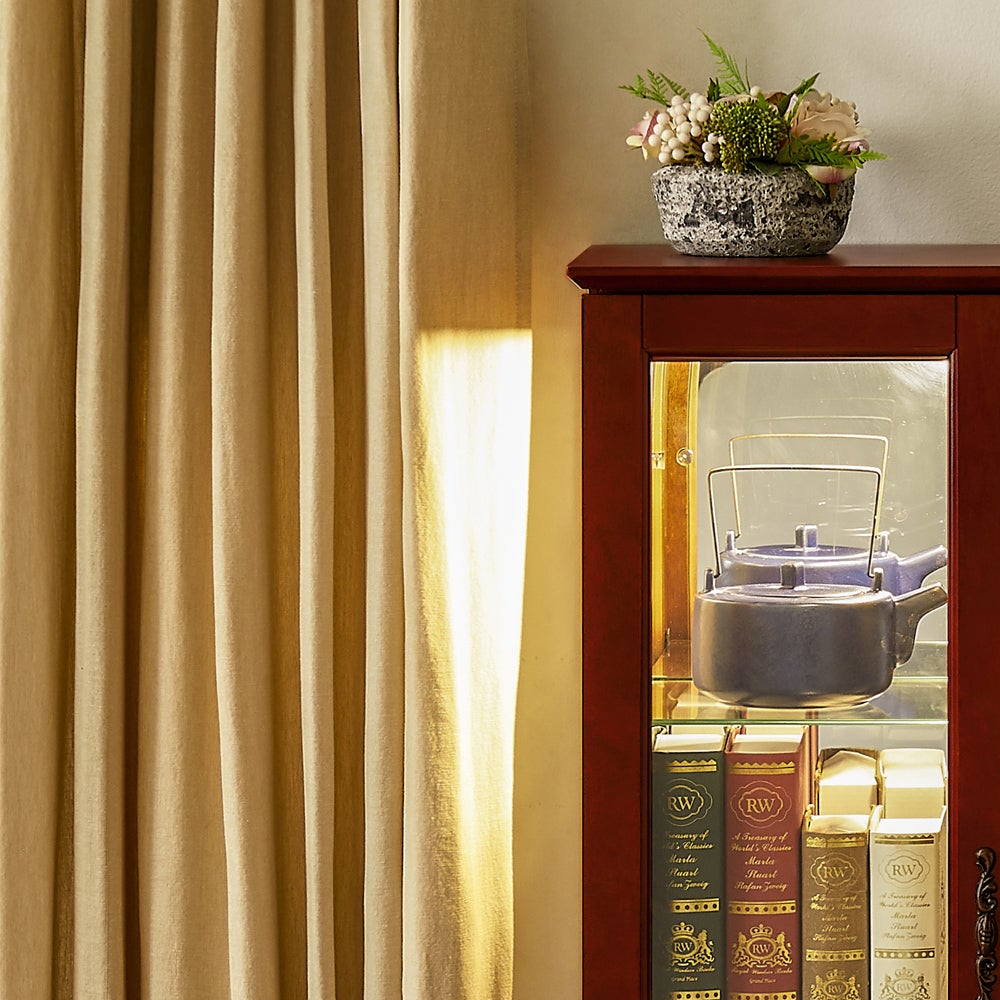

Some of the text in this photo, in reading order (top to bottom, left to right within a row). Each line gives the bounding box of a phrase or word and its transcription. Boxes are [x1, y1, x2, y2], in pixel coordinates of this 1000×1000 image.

[668, 796, 695, 811] RW
[746, 798, 775, 813] RW
[778, 832, 788, 842] of
[823, 866, 848, 879] RW
[892, 864, 916, 877] RW
[674, 942, 692, 952] RW
[752, 944, 771, 954] RW
